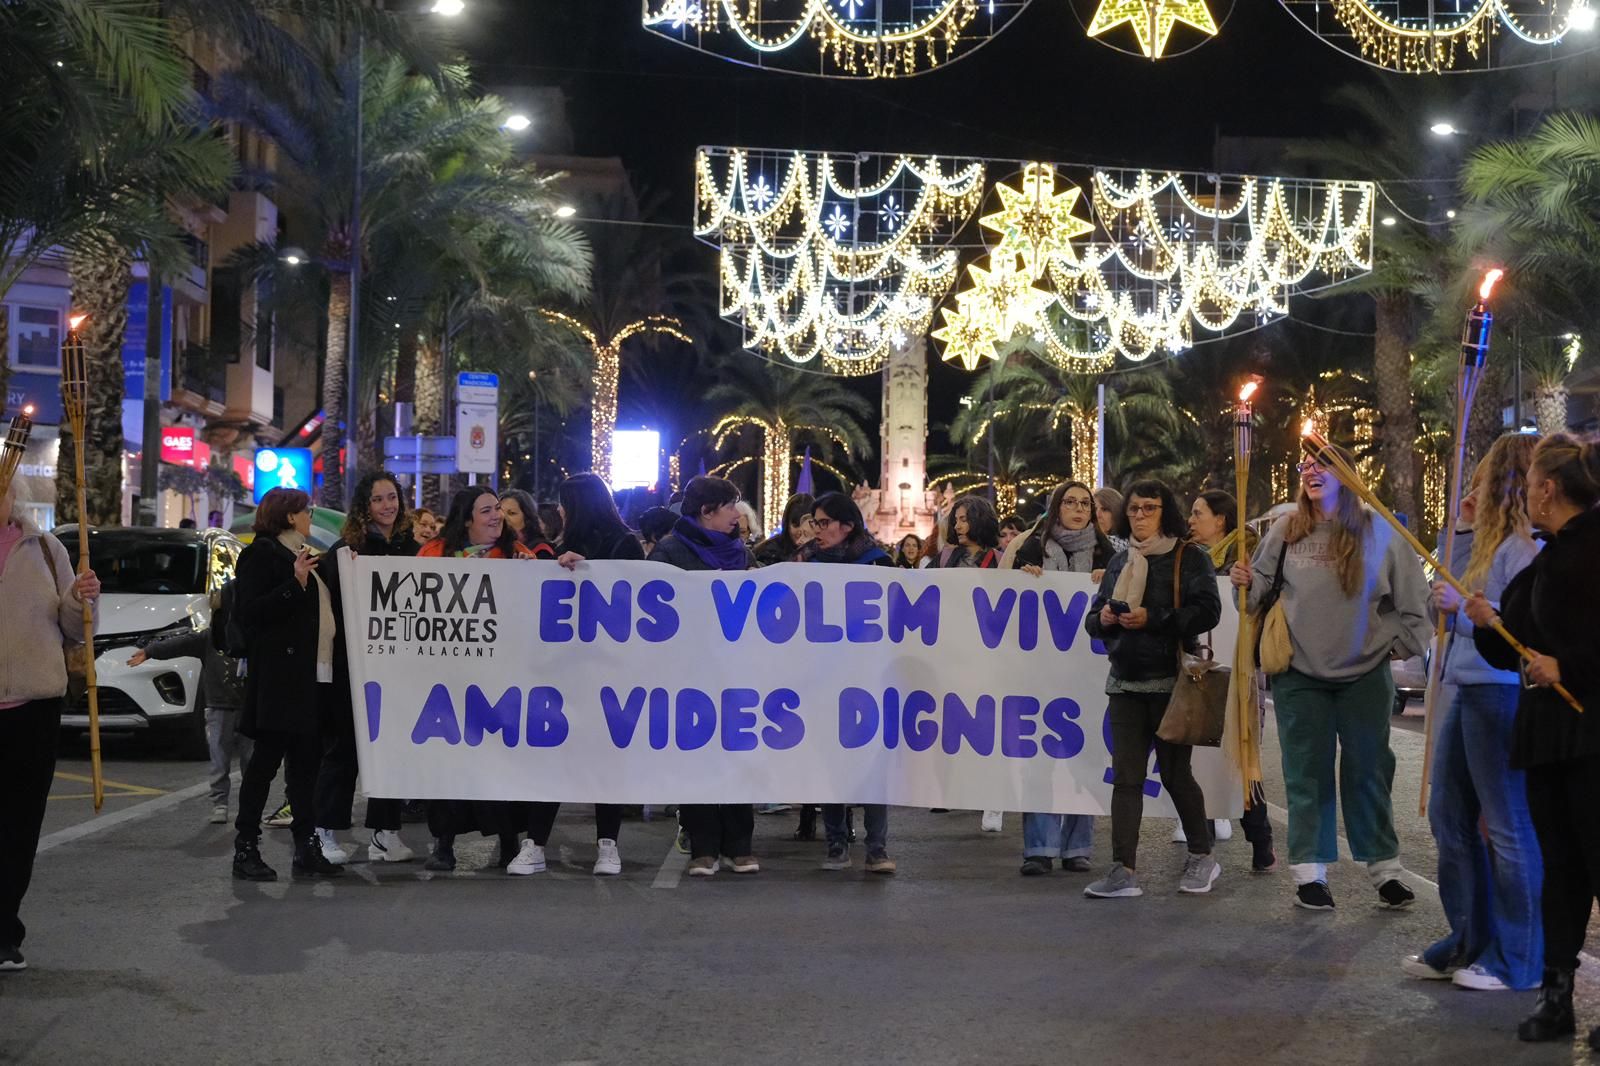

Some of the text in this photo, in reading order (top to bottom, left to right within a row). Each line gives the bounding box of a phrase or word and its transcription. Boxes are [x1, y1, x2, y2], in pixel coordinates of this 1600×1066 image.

[163, 435, 193, 447] GAES
[368, 611, 498, 643] DE TORXES
[539, 578, 1109, 655] ENS VOLEM VIV
[367, 644, 495, 658] 25N ALACANT
[363, 680, 1085, 759] I AMB VIDES DIGNES
